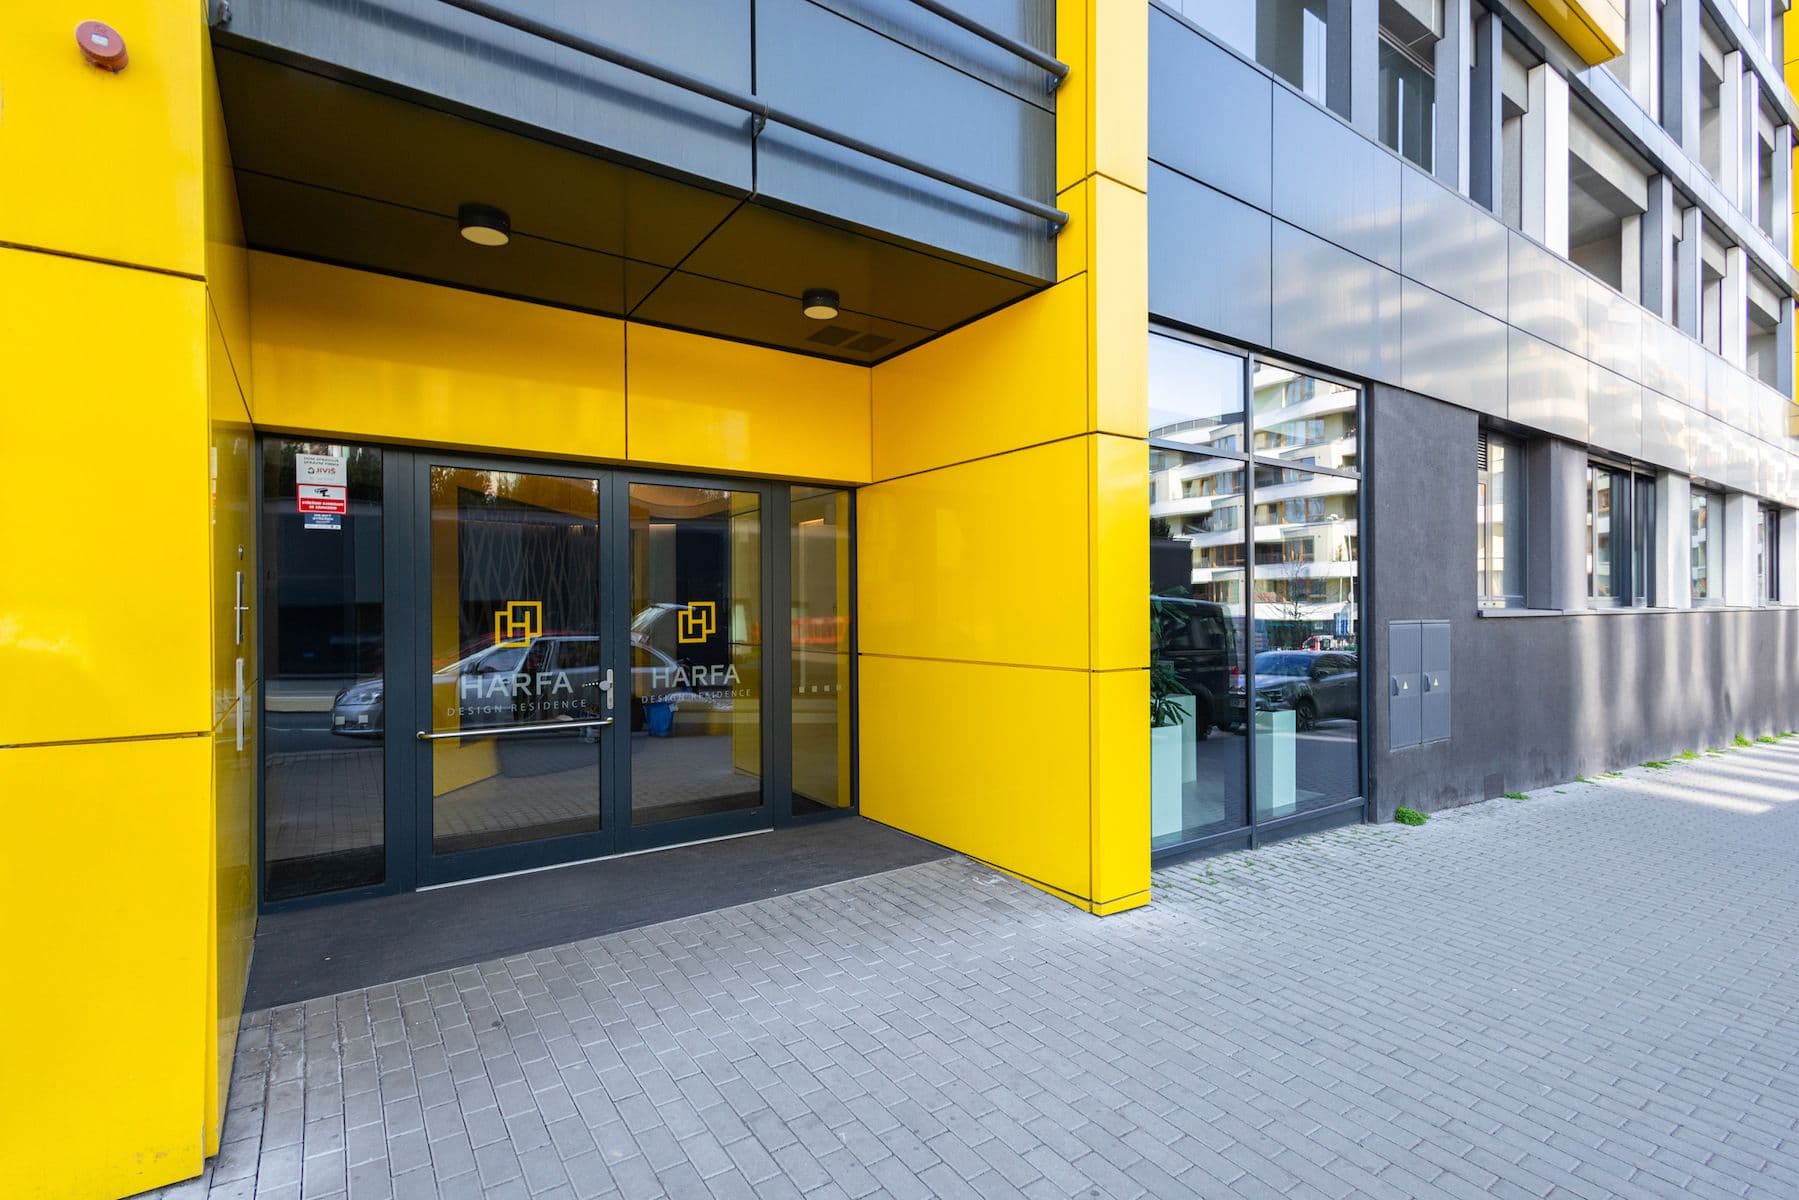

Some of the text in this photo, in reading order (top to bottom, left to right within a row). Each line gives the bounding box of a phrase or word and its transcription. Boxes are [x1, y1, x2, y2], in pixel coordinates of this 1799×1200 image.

[461, 671, 574, 699] HARFA
[652, 664, 741, 689] HARFA
[447, 699, 587, 716] DESIGN RESIDENCE
